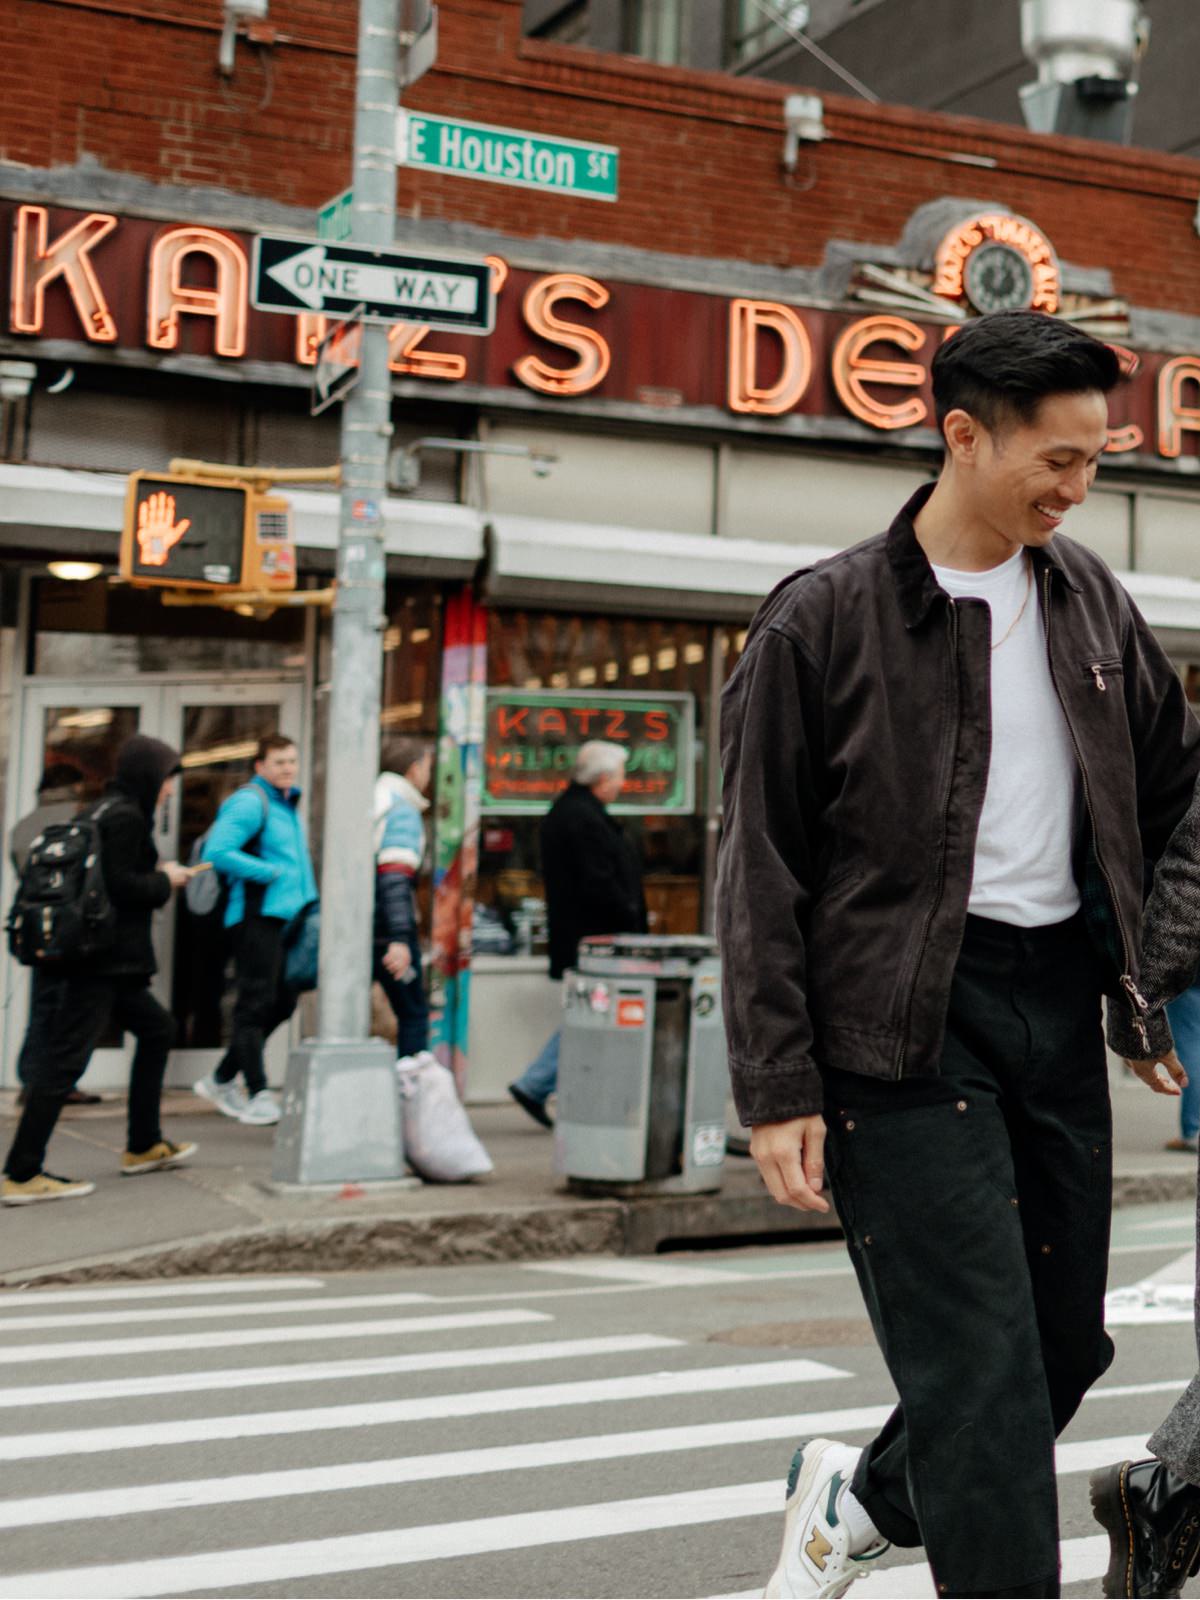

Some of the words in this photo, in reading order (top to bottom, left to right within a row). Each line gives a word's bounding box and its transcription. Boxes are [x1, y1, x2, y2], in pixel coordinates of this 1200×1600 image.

[410, 120, 427, 162] E
[438, 124, 576, 188] Houston
[586, 151, 610, 180] St
[10, 204, 611, 396] KA'S
[294, 263, 360, 295] ONE
[393, 274, 461, 302] WAY
